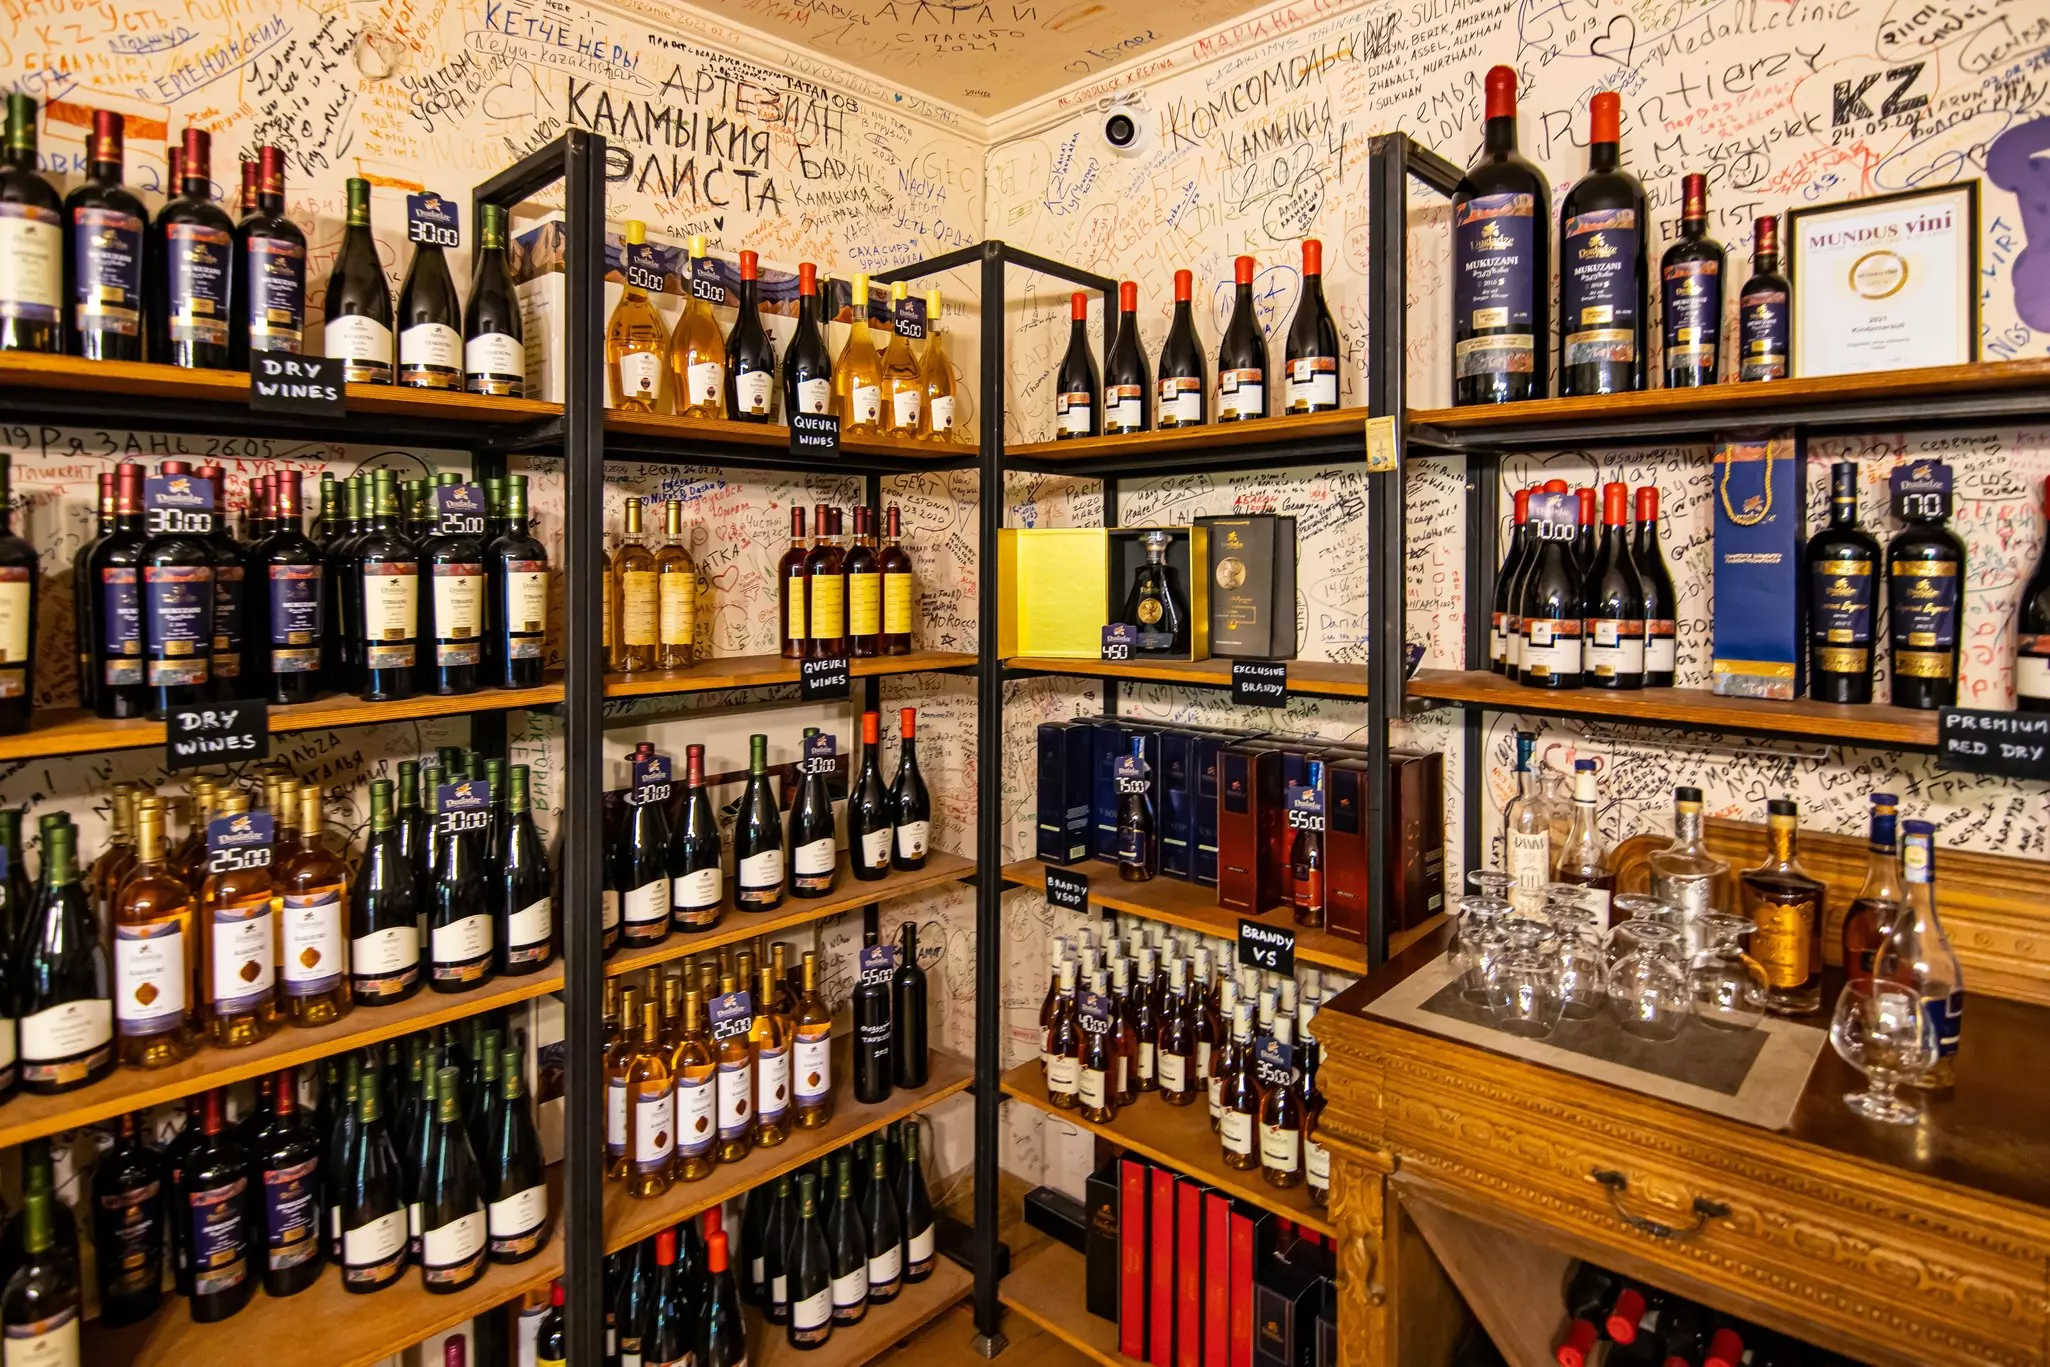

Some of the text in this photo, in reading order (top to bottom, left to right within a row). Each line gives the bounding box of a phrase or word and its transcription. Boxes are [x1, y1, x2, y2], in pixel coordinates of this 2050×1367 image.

[485, 0, 640, 72] КЕТЧЕНЕРЫ
[1832, 61, 1929, 127] KZ
[566, 76, 770, 171] КАЛМЫКИЯ
[410, 221, 459, 248] 30.00
[1808, 222, 1899, 257] MUNDUS
[1904, 206, 1953, 241] vini
[1465, 255, 1519, 272] MUKUZANI
[1573, 261, 1623, 277] MUKUZANI
[628, 266, 663, 291] 50.00
[692, 278, 725, 303] 50.00
[895, 323, 923, 342] 45.00
[262, 358, 322, 380] DRY
[256, 384, 339, 404] WINES
[793, 414, 838, 433] QVEVRI
[799, 436, 834, 449] WINES
[894, 474, 941, 497] GERT
[148, 507, 213, 534] 30.00
[441, 512, 485, 534] 25.00
[1531, 517, 1576, 541] 70.00
[1102, 644, 1129, 660] 450
[803, 660, 847, 675] QVEVRI
[1233, 664, 1286, 678] EXCLUSIVE
[809, 675, 847, 690] WINES
[1241, 681, 1284, 698] BRANDY
[176, 710, 239, 731] DRY
[1945, 714, 2050, 734] PREMIUM
[175, 734, 257, 756] WINES
[1948, 738, 2044, 761] RED DRY
[807, 757, 836, 773] 30.00
[1115, 775, 1145, 794] 75.00
[637, 785, 671, 806] 30.00
[438, 809, 488, 833] 30.00
[209, 846, 272, 874] 25.00
[1047, 875, 1088, 897] BRANDY
[1054, 891, 1083, 905] VSOP
[1241, 924, 1294, 951] BRANDY
[1253, 947, 1277, 967] VS
[861, 968, 894, 987] 55.00
[713, 1016, 752, 1041] 25.00
